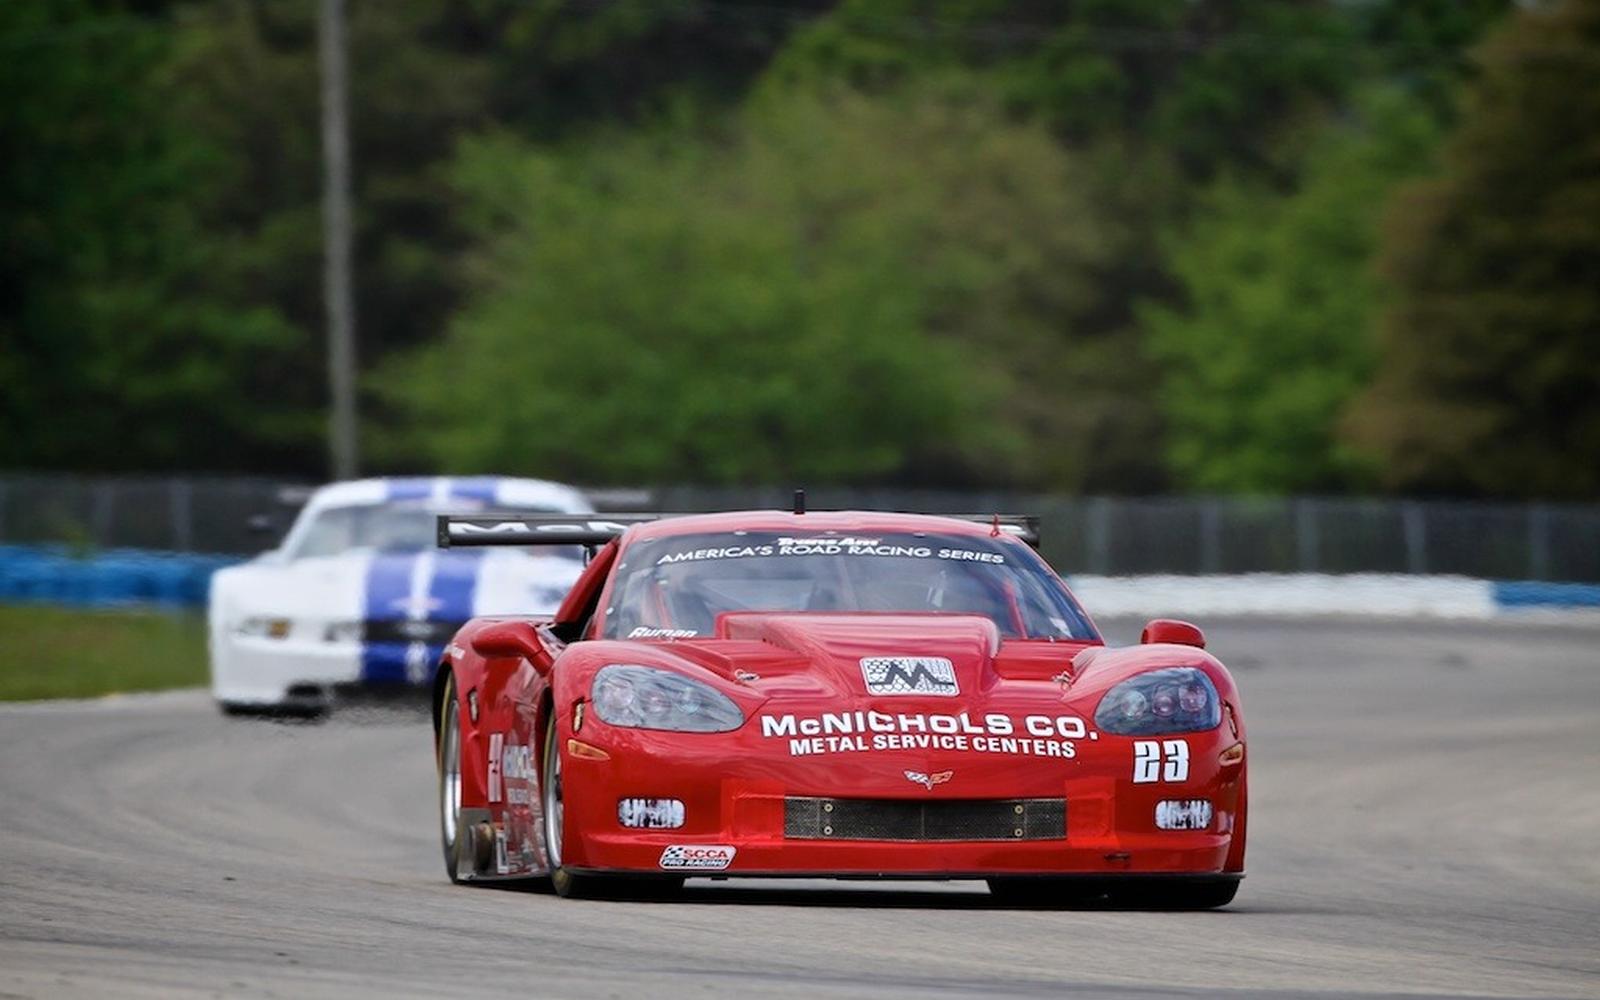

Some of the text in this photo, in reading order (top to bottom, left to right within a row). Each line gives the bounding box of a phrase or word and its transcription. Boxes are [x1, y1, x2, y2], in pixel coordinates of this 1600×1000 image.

[657, 545, 1005, 565] AMERICA'S ROAD RACING SERIES
[627, 626, 699, 638] Ruman
[760, 709, 1099, 741] McNICHOLS CO.
[789, 734, 1077, 759] METAL SERVICE CENTERS
[1132, 739, 1190, 784] 23
[683, 849, 729, 859] SCCA
